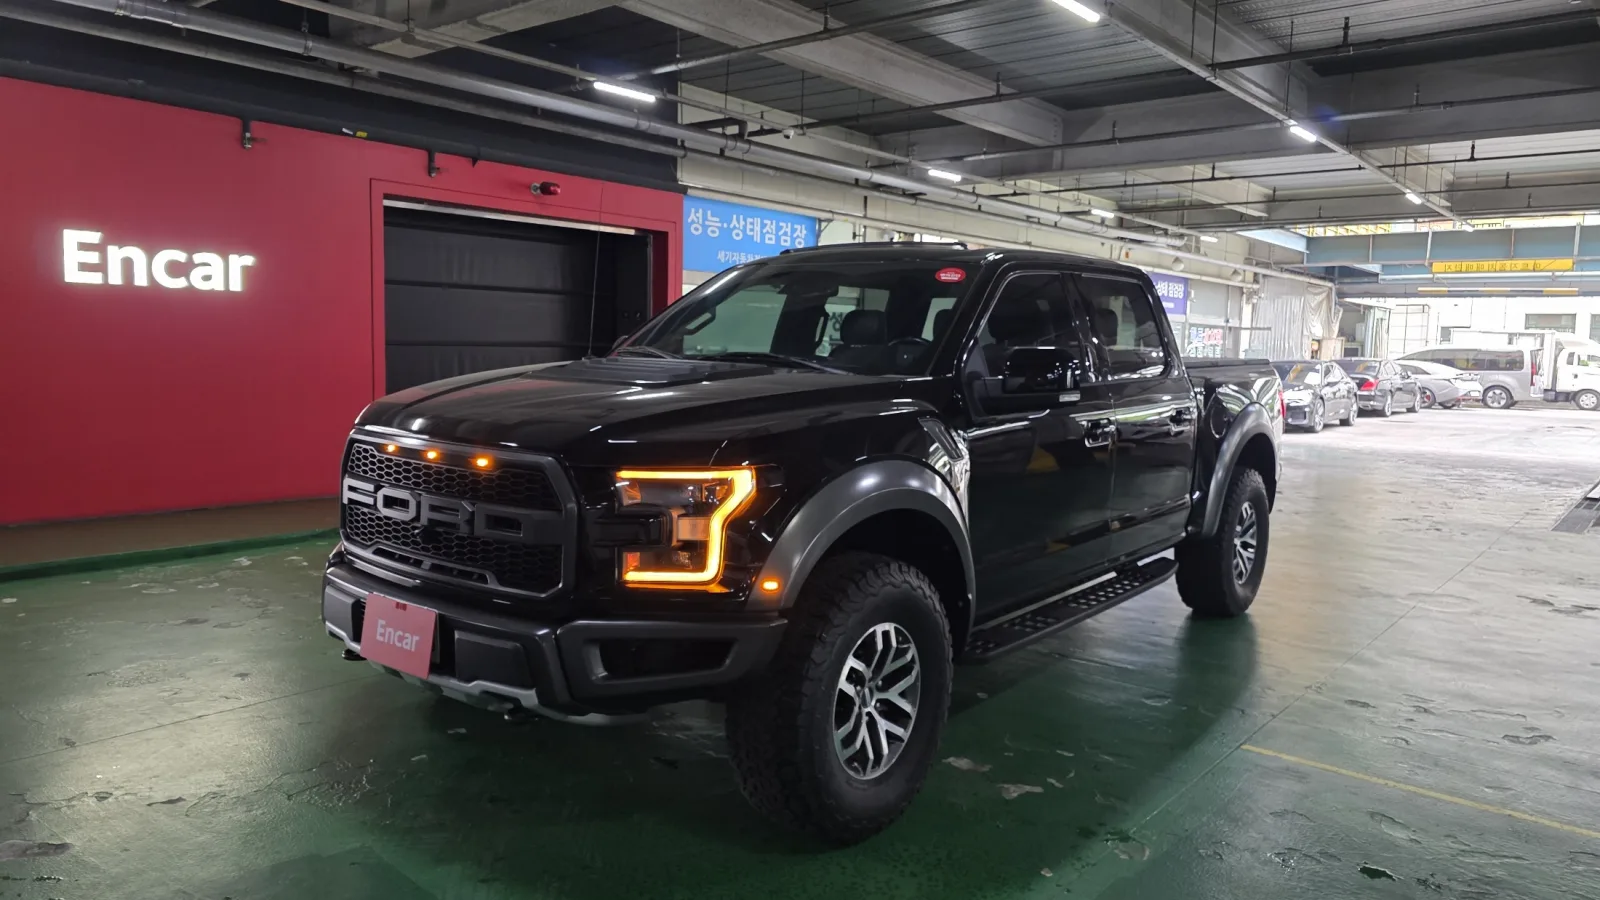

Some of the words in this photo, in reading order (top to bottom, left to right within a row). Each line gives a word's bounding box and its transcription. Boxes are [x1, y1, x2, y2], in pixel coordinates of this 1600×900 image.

[687, 207, 807, 248] 성능·상태점검장
[63, 228, 256, 292] Encar
[343, 477, 531, 541] FORD
[376, 619, 420, 652] Encar
